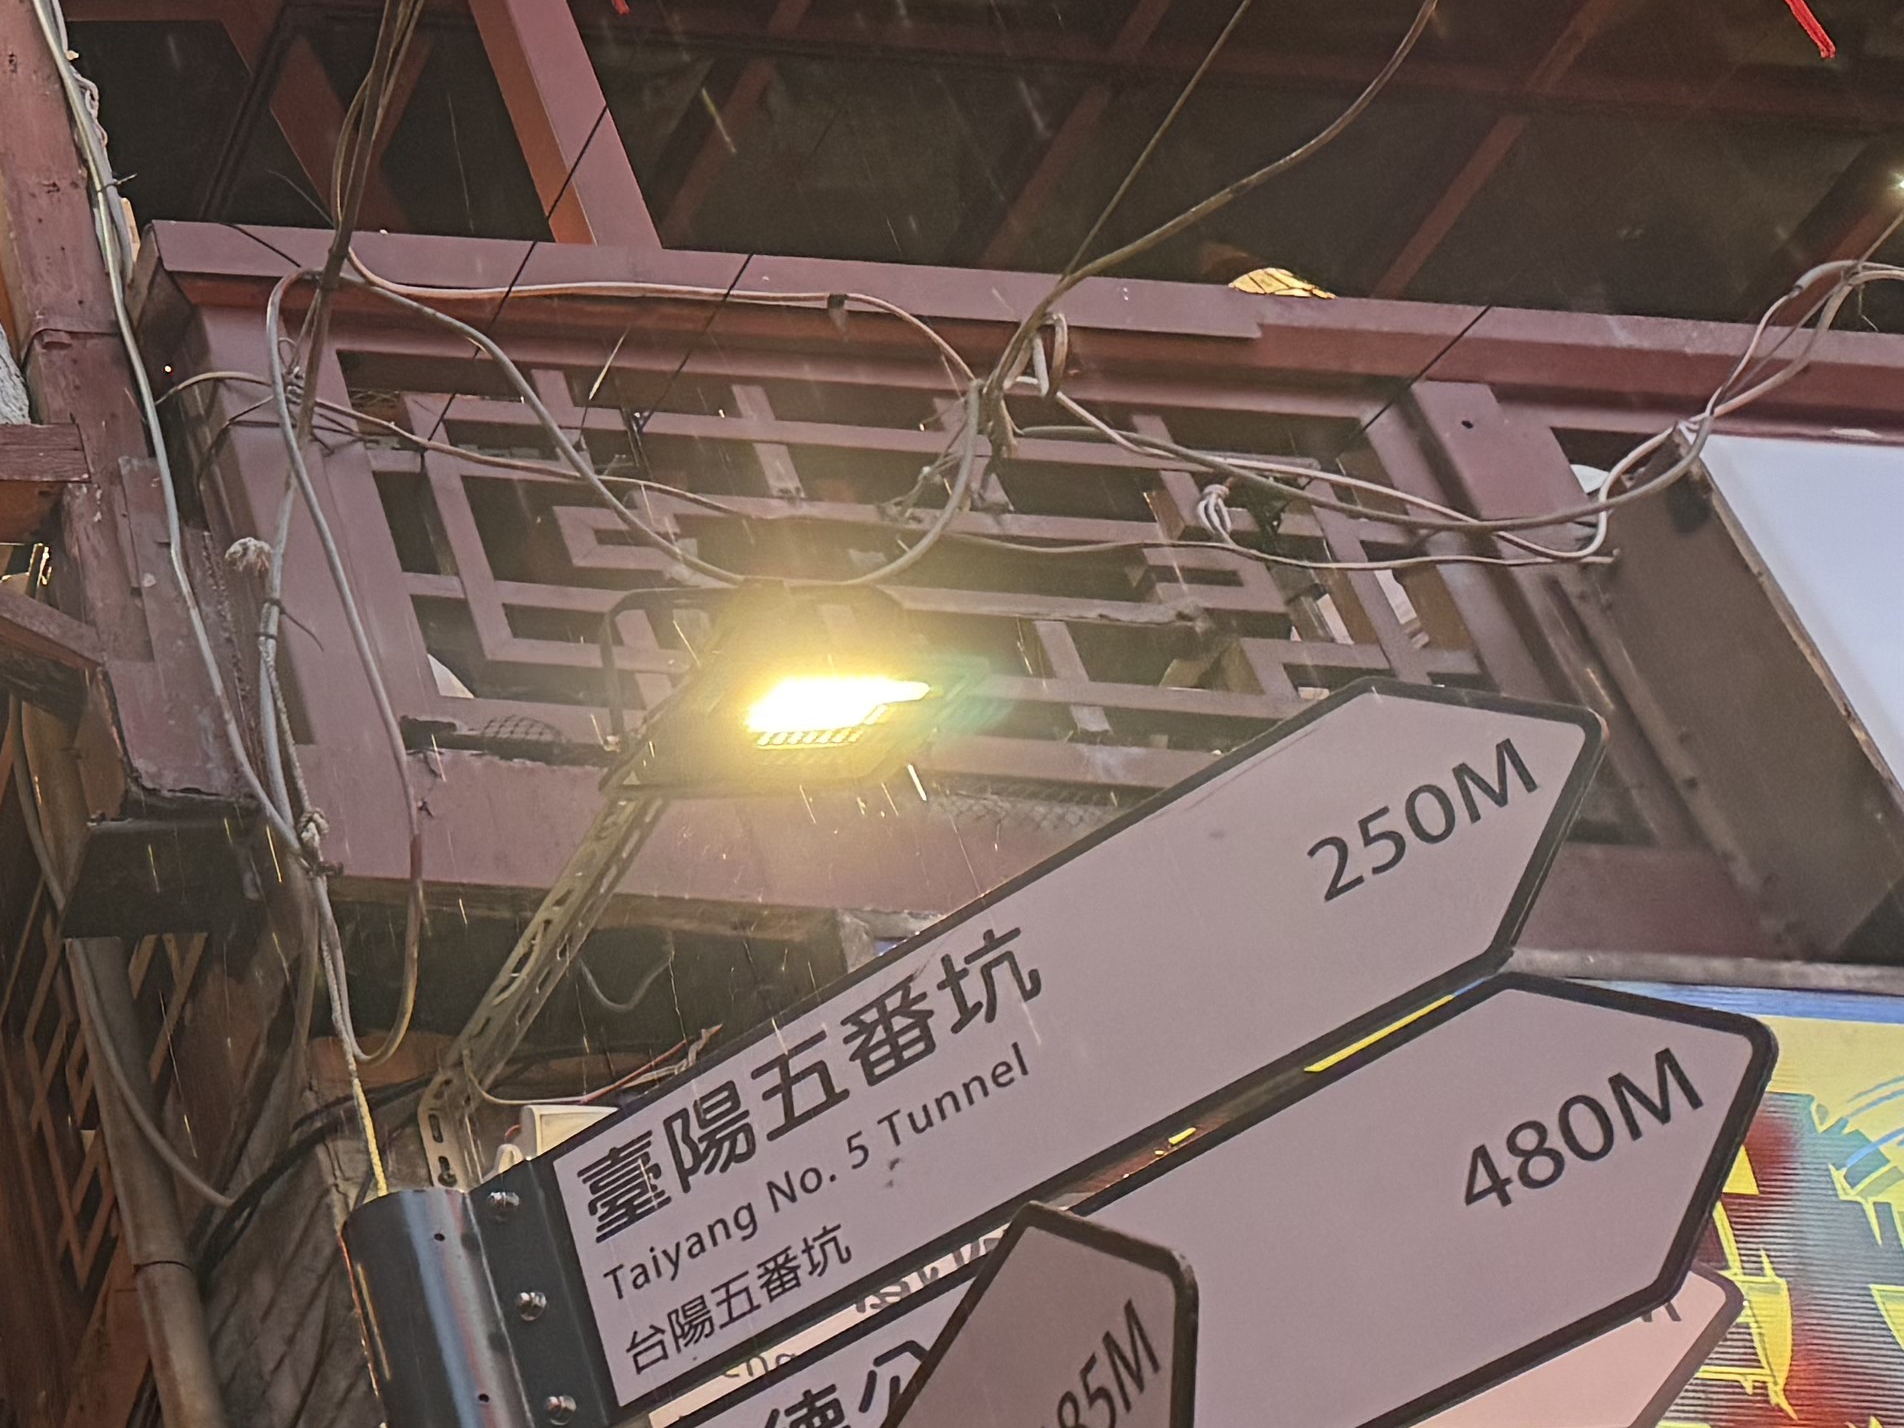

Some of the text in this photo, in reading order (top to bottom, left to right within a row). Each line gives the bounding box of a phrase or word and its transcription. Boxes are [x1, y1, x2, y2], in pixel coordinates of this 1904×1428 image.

[1306, 738, 1539, 902] 250M
[577, 926, 1042, 1244] 臺陽五番坑
[1463, 1047, 1704, 1209] 480M
[603, 1041, 1031, 1301] Taiyang No. 5 Tunnel
[626, 1224, 853, 1375] 台陽五番坑
